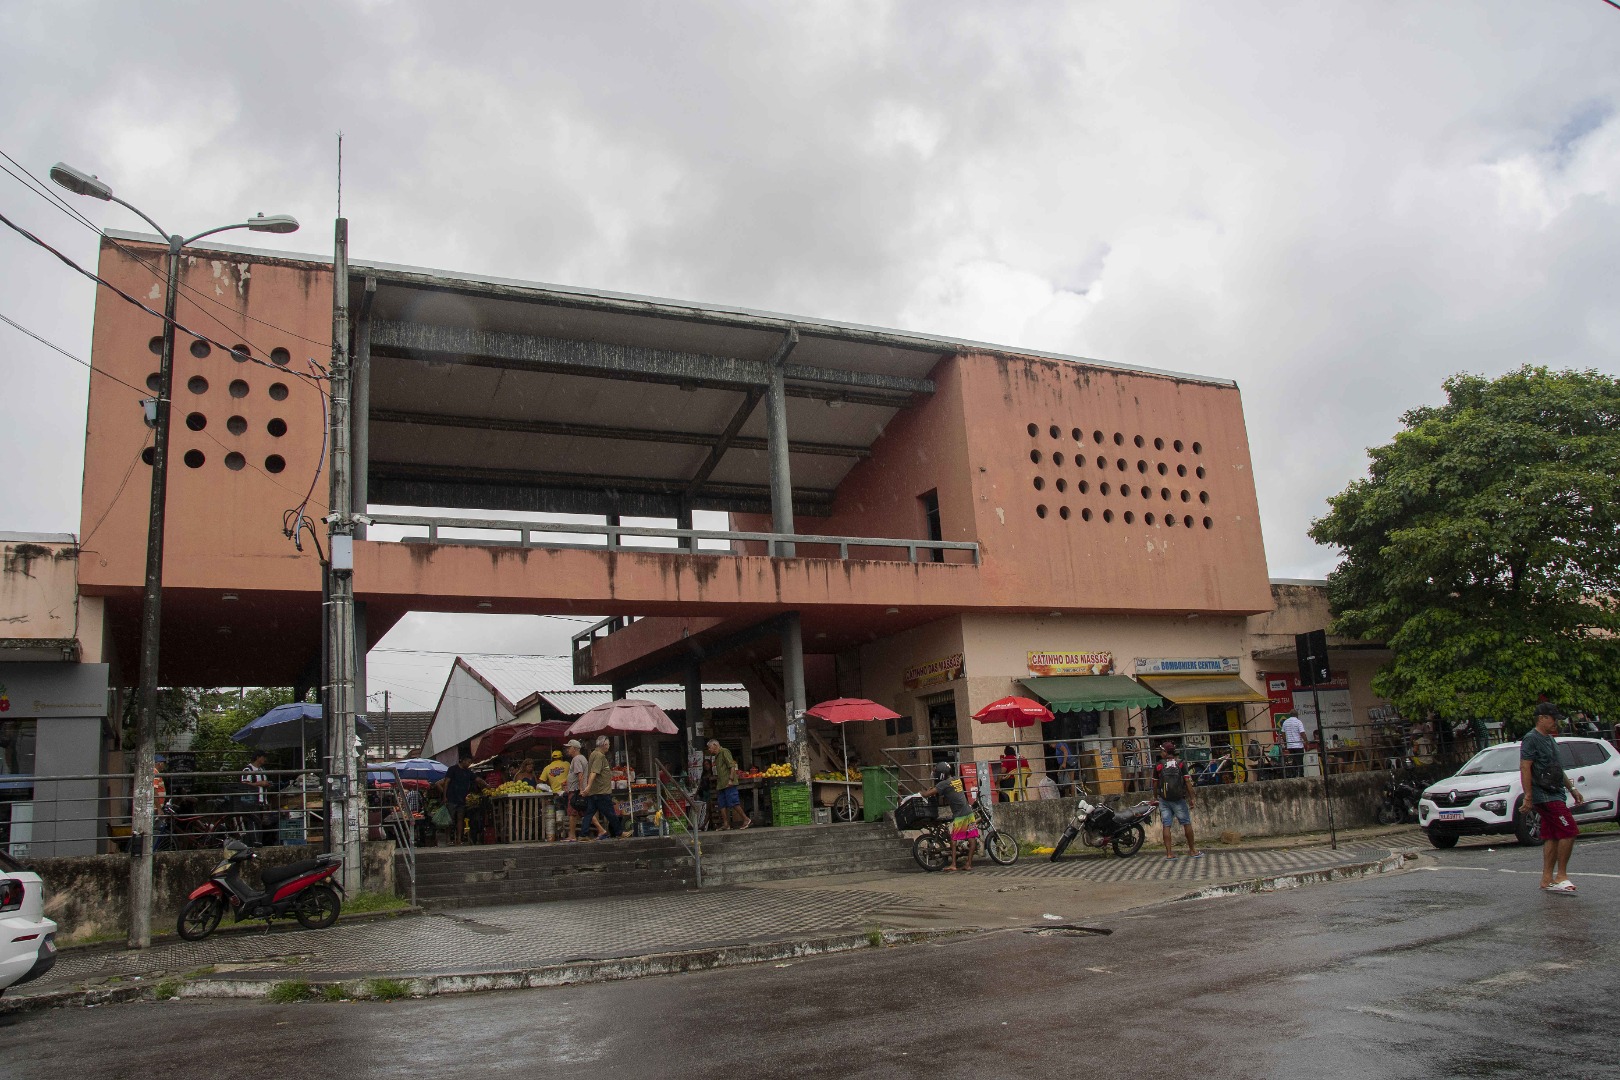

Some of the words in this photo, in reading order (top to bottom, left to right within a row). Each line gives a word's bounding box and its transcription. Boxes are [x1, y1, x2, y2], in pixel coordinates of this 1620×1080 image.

[1031, 654, 1064, 665] CATINHO
[1065, 654, 1079, 665] DAS
[1080, 654, 1109, 664] MASSAS
[1160, 661, 1198, 670] BOMBONIERE
[1198, 660, 1221, 670] CENTRAL
